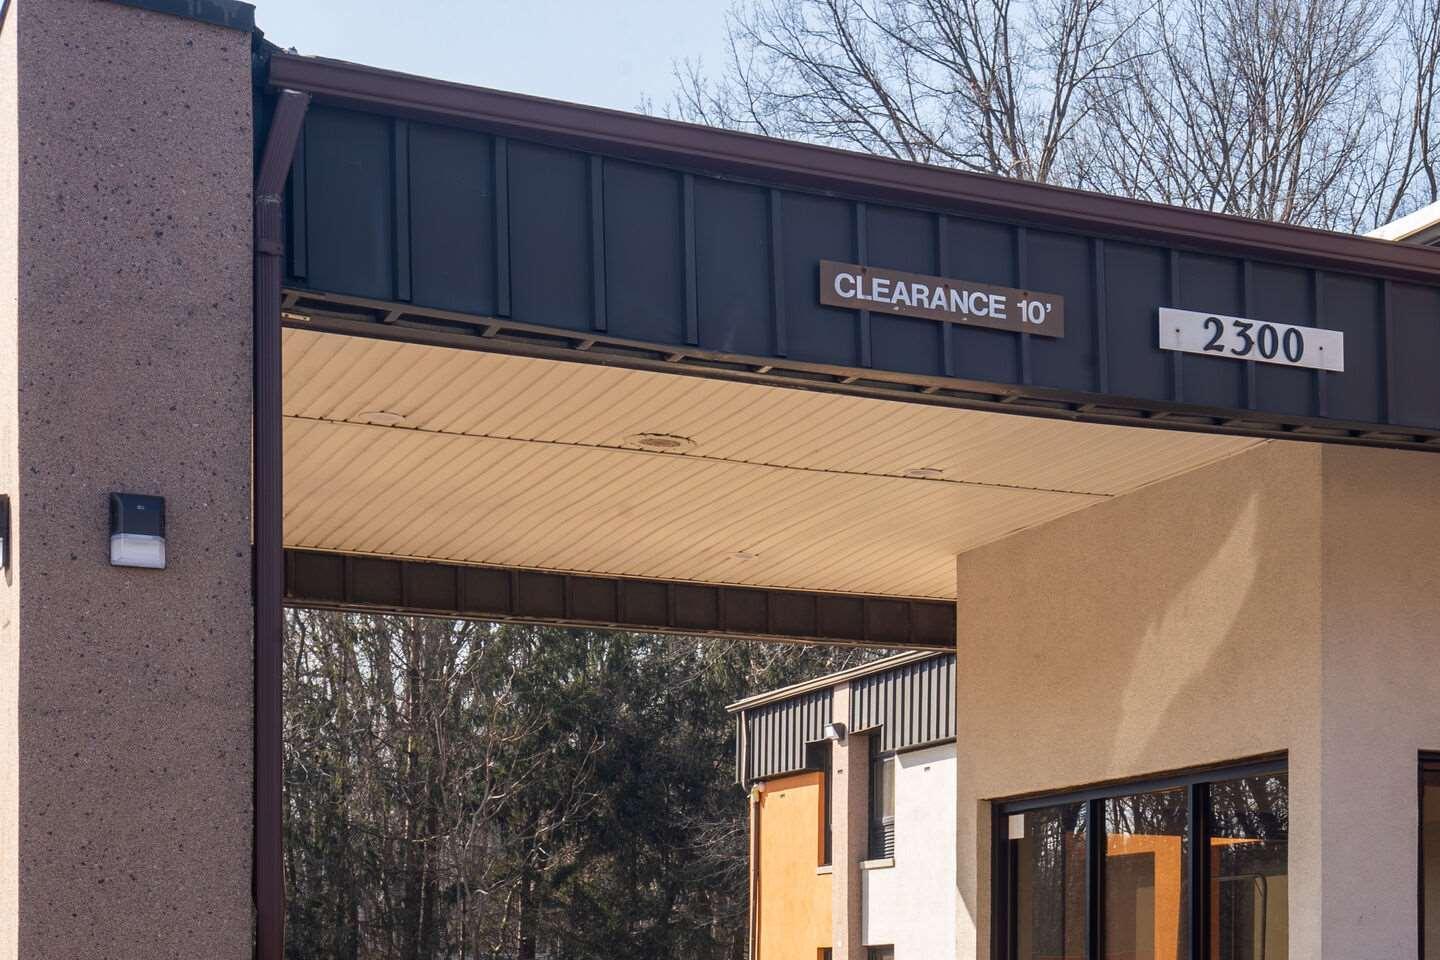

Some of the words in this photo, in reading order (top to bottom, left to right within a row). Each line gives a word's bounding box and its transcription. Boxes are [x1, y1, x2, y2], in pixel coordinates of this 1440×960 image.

[834, 272, 1007, 320] CLEARANCE
[1016, 299, 1052, 325] 10'
[1202, 316, 1304, 363] 2300
